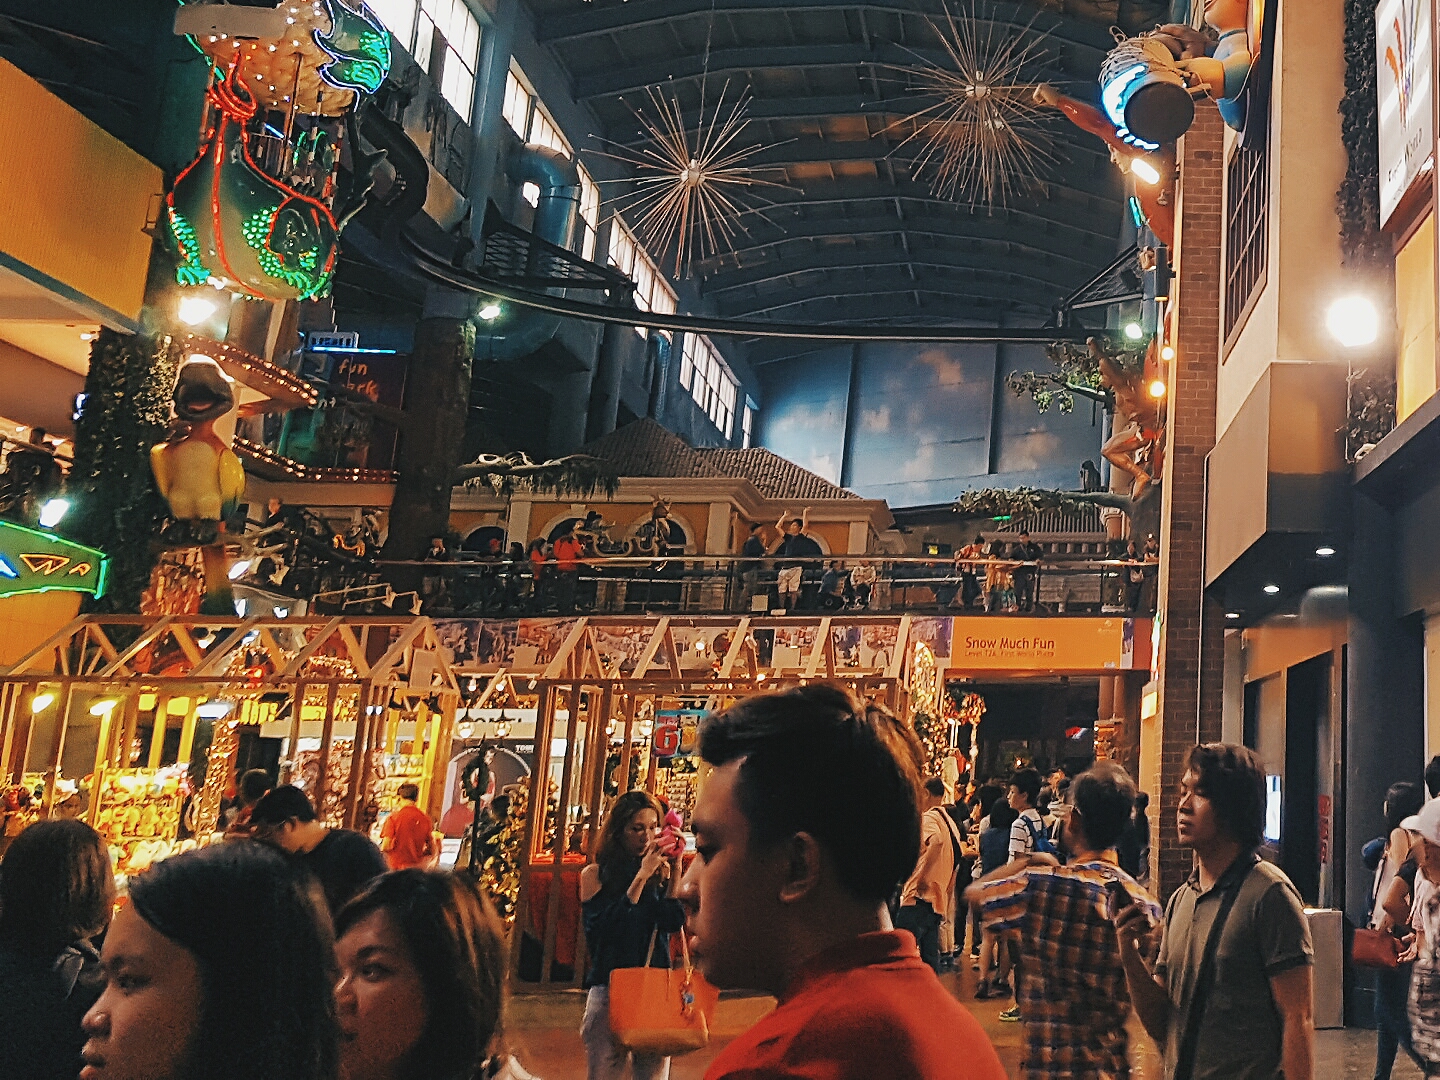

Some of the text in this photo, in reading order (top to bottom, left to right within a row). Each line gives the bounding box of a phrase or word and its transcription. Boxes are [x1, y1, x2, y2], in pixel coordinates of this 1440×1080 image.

[966, 636, 1055, 650] Snow Much Fun
